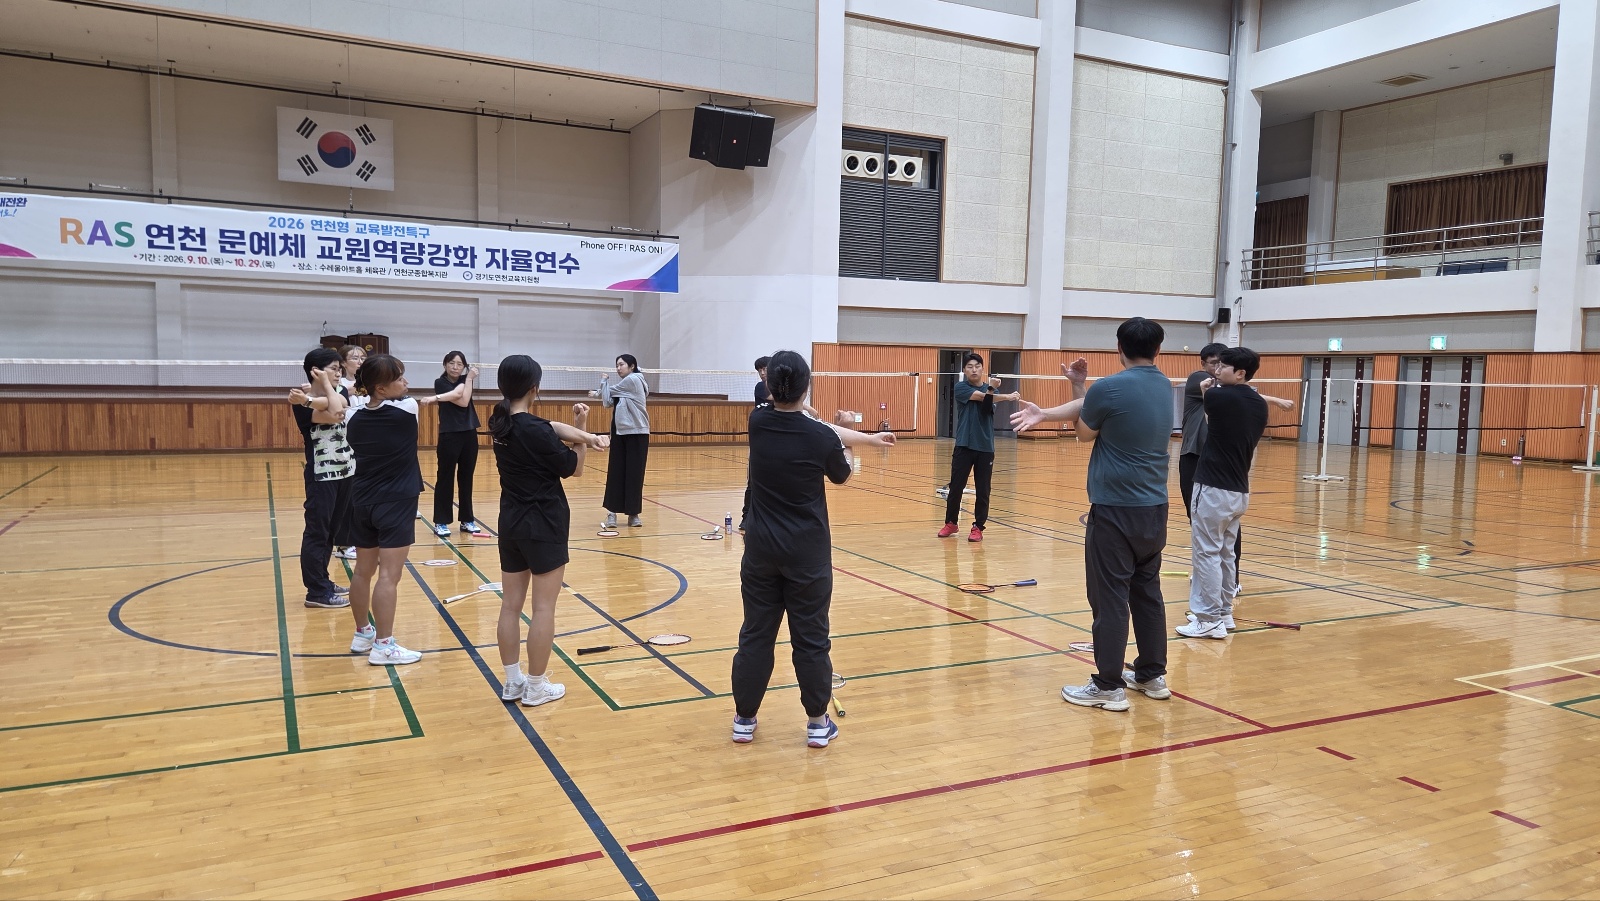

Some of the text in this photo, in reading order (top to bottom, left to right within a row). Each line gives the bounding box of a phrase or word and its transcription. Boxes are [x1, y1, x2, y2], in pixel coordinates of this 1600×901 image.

[268, 216, 431, 239] 2026 연천형 교육발전특구
[59, 217, 581, 275] RAS 연천 문예체 교원역량강화 자율연수
[580, 240, 605, 250] Phone
[629, 244, 646, 253] RAS
[139, 253, 156, 262] 기간
[297, 262, 313, 271] 장소
[365, 268, 387, 276] 체육관
